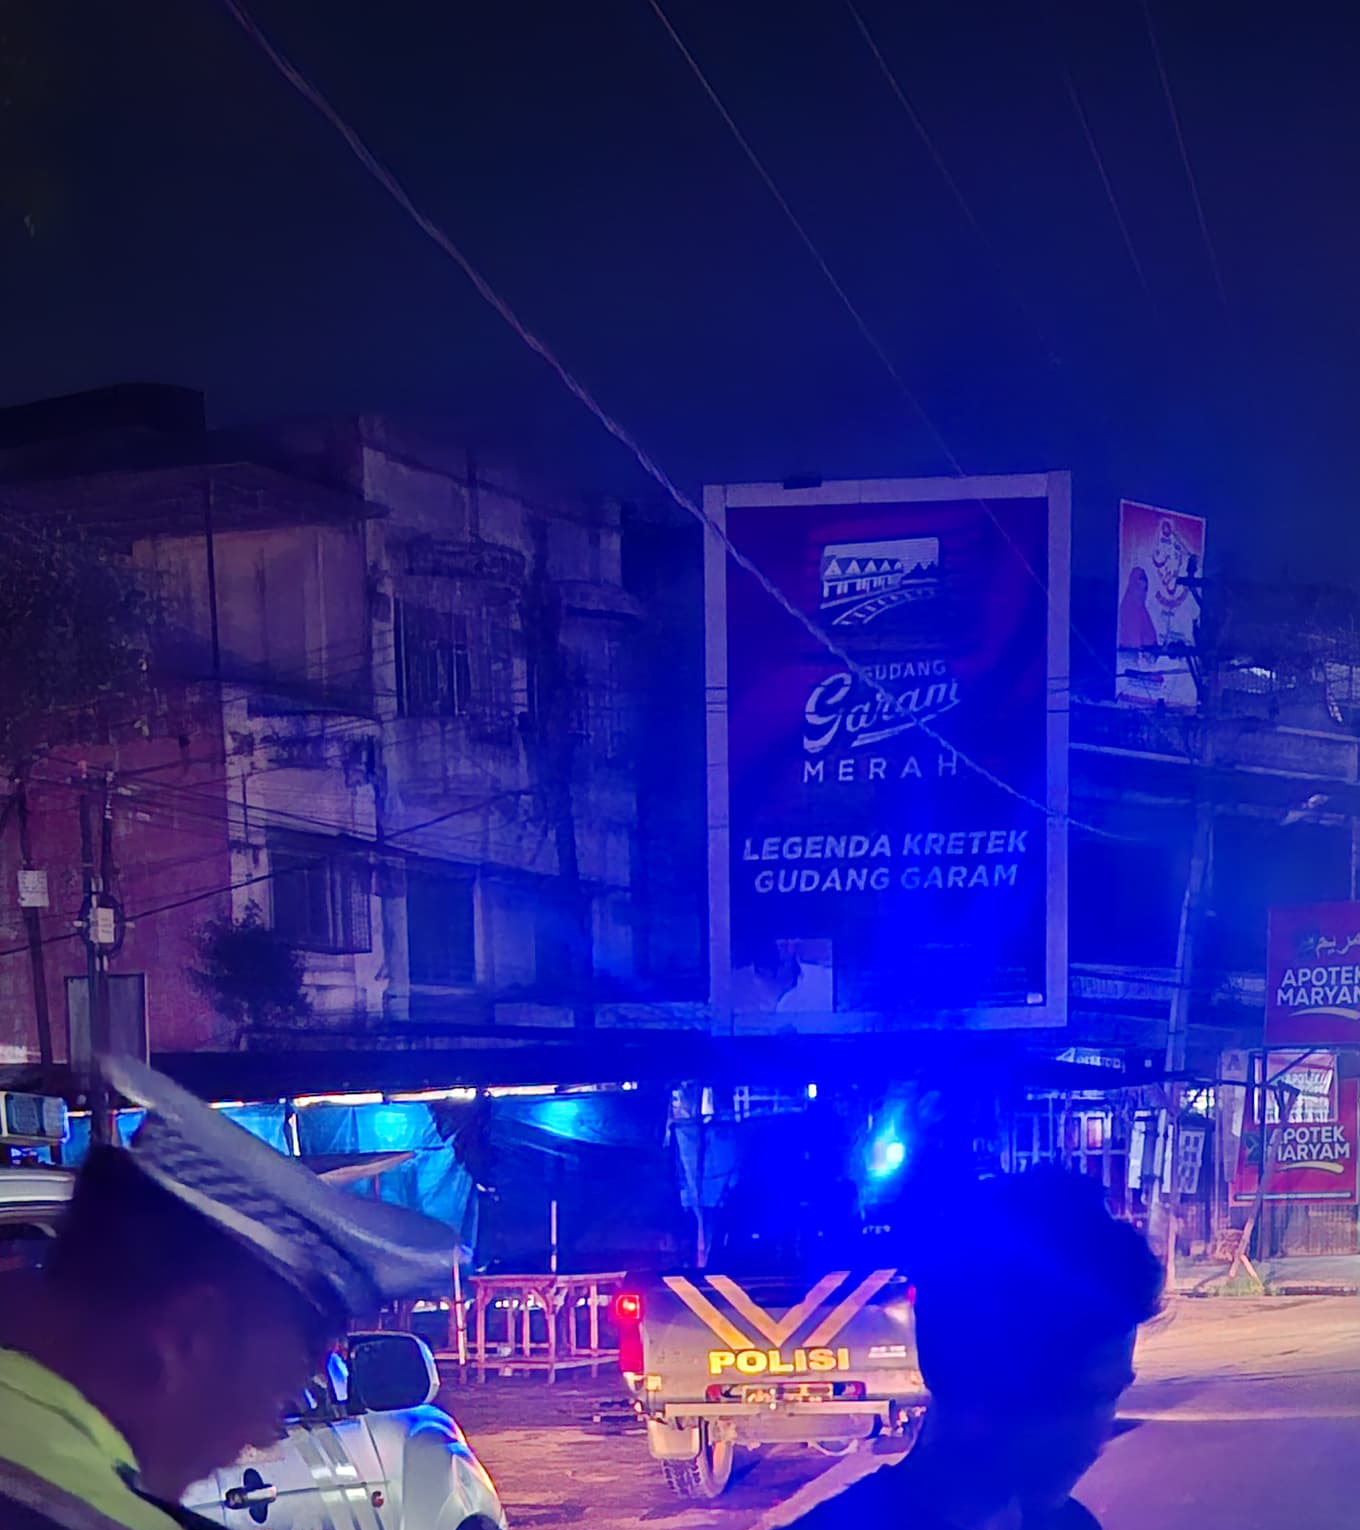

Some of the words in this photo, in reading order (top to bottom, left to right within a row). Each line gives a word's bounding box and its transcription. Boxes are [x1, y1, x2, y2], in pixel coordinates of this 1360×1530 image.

[803, 672, 961, 754] Garam
[803, 752, 958, 784] MERAH
[742, 833, 892, 861] LEGENDA
[902, 829, 1029, 857] KRETEK
[754, 867, 890, 893] GUDANG
[900, 863, 1018, 890] GARAM
[708, 1347, 850, 1375] POLISI
